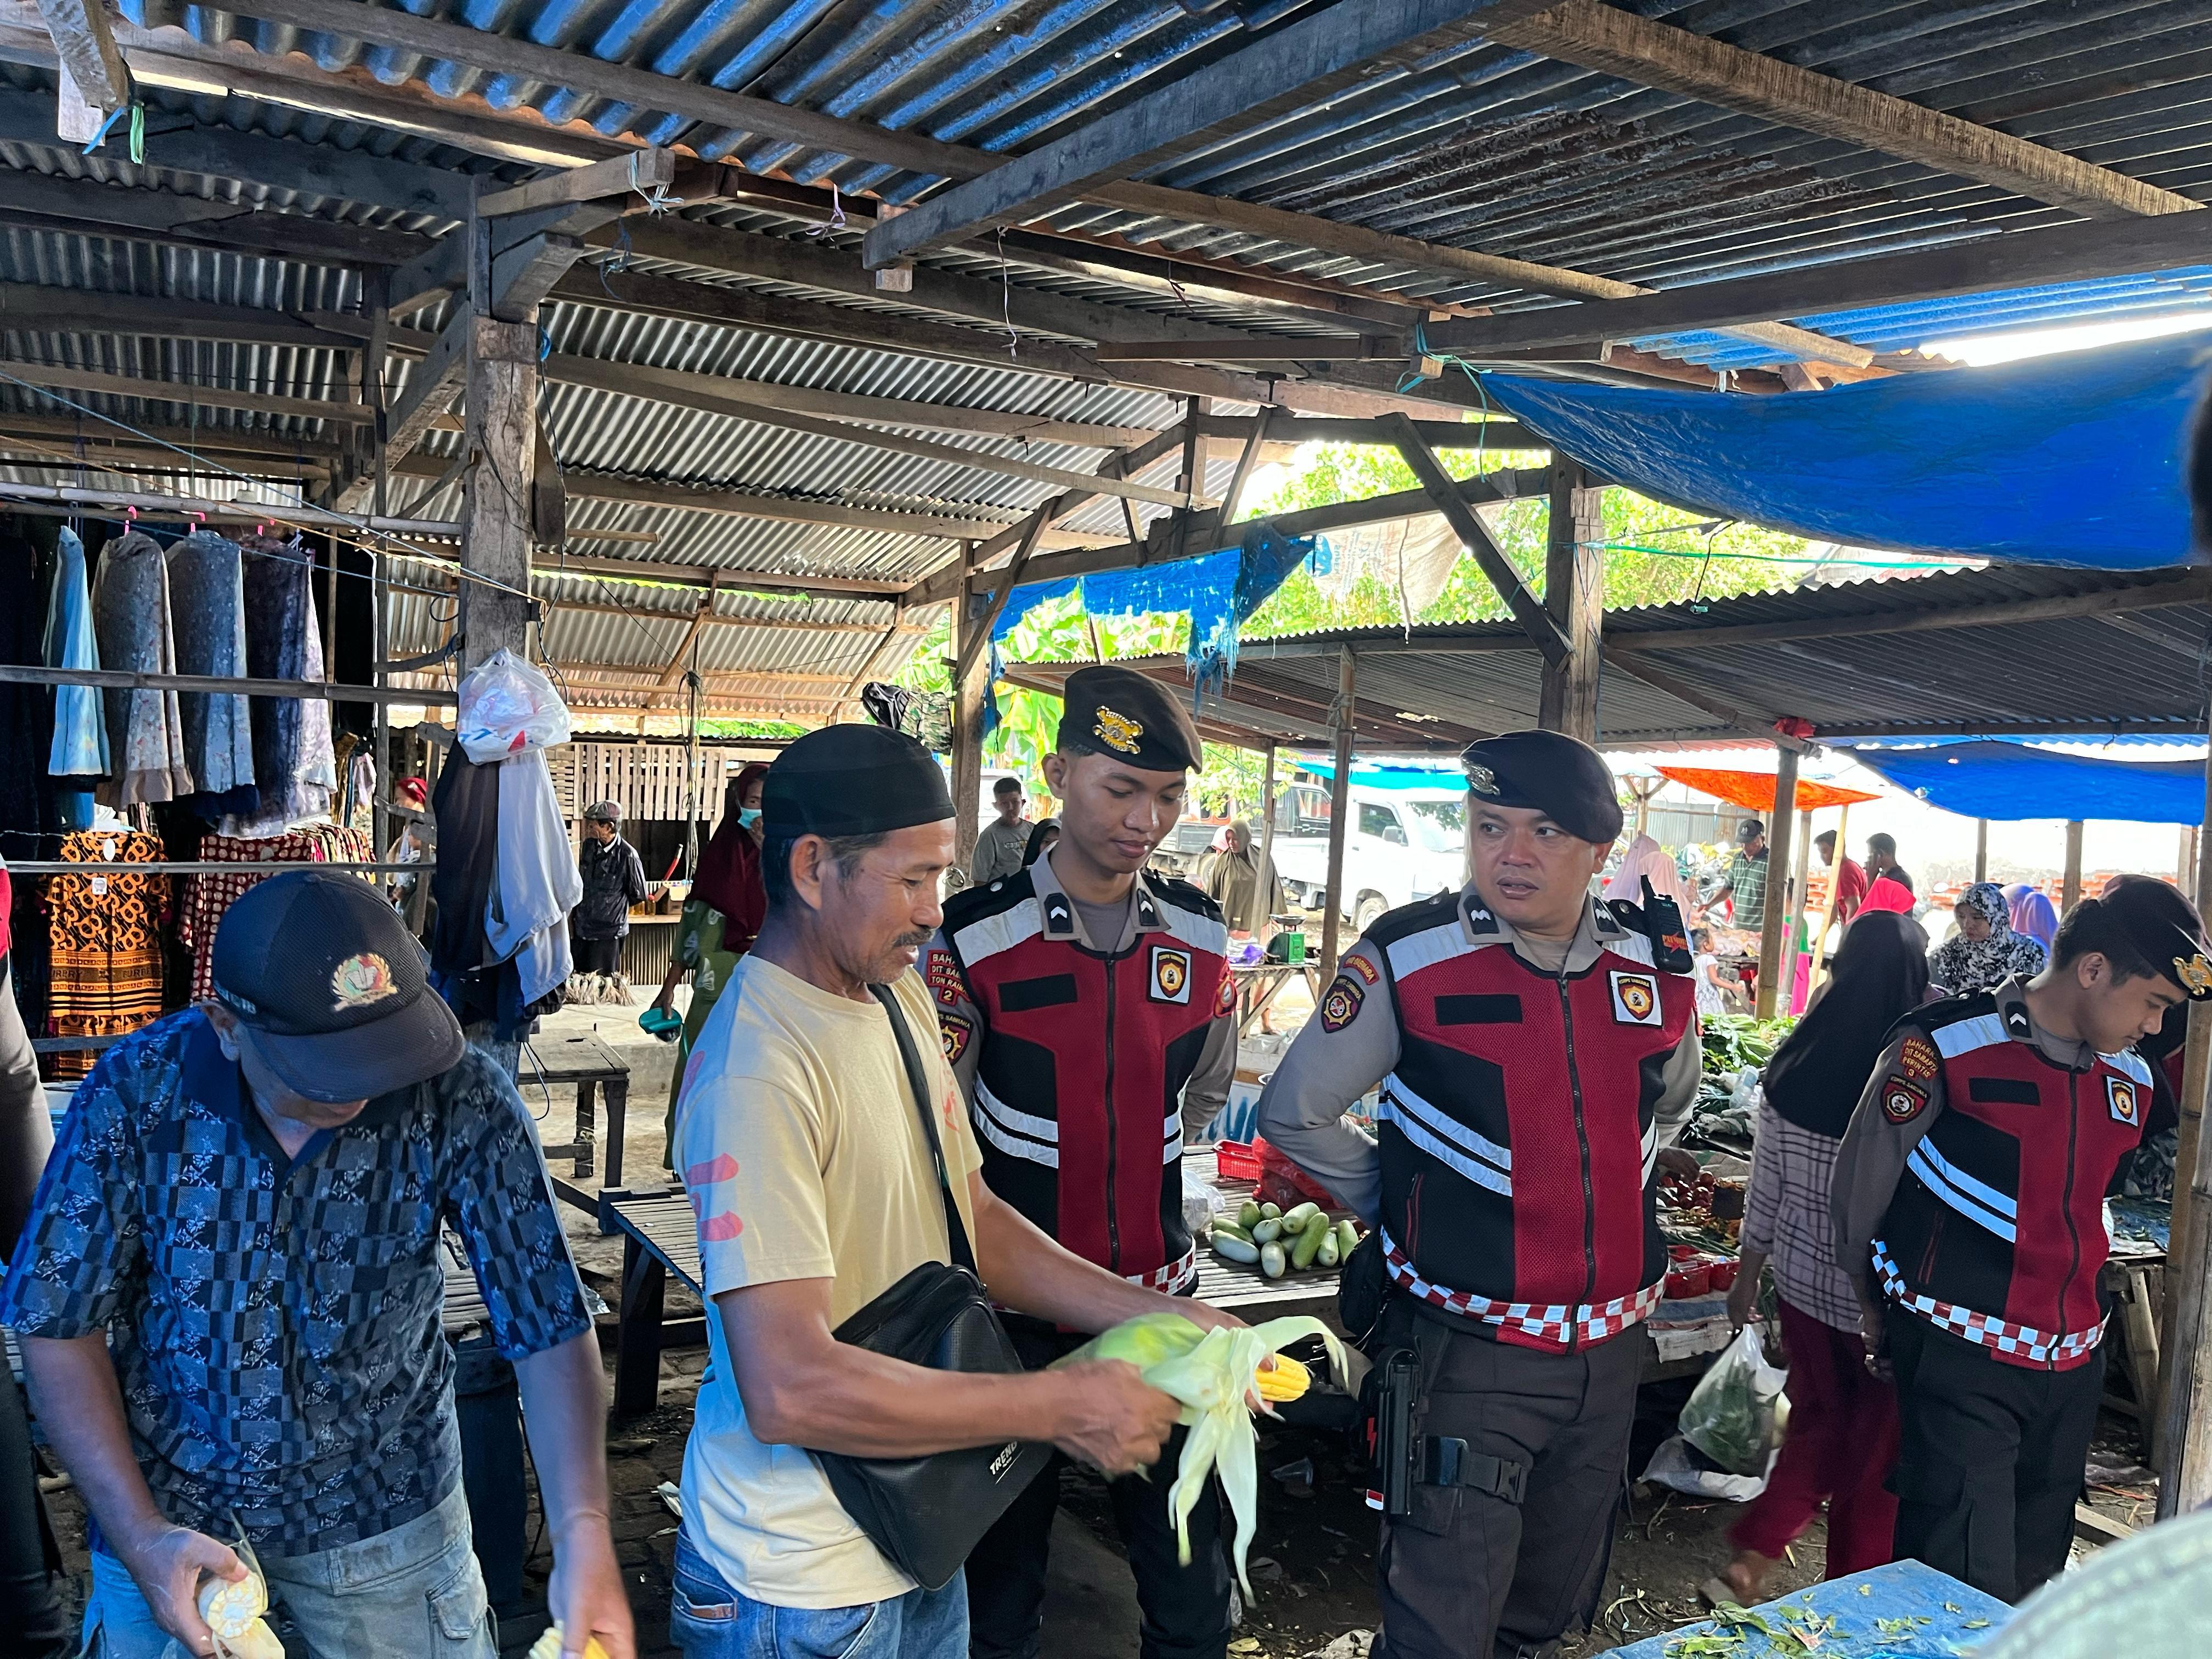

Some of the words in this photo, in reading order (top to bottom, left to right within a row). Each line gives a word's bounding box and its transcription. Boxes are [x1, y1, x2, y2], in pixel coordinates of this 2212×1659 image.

[932, 966, 944, 974] DIT
[931, 976, 945, 985] TON
[943, 990, 953, 1001] 2
[1903, 1056, 1931, 1078] PERINTIS
[990, 1441, 1018, 1475] TREND
